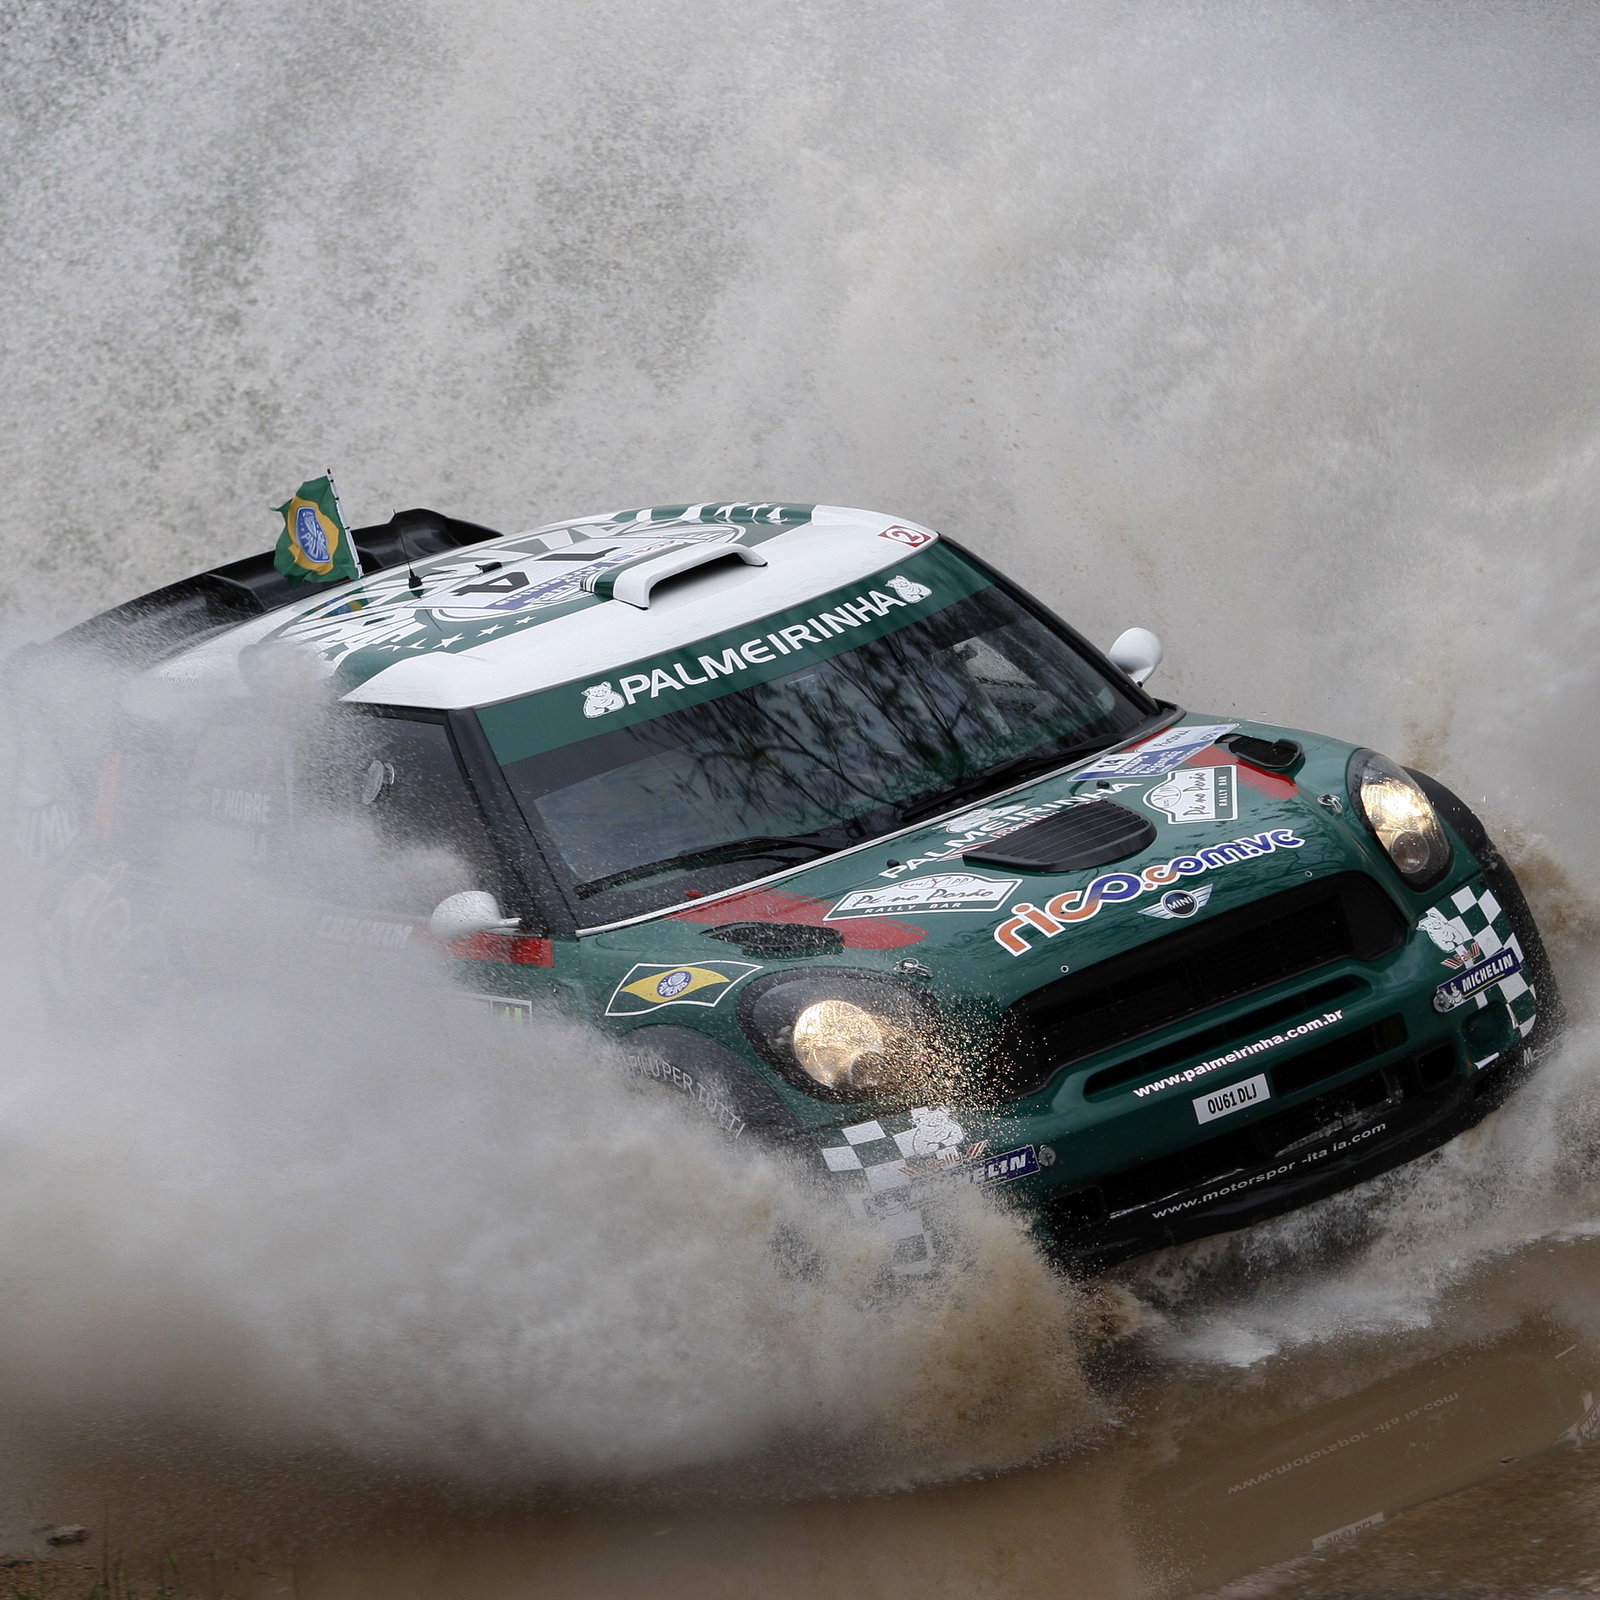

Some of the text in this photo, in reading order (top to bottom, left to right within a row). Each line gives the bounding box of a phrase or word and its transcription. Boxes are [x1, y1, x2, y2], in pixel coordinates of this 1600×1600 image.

[891, 530, 921, 542] 2
[618, 589, 908, 706] PALMEIRINHA
[1218, 789, 1228, 807] RALLY
[878, 782, 1145, 880] PALMEIRINHA
[864, 904, 917, 914] RALLY
[994, 829, 1306, 957] rico.com.vc
[1167, 896, 1194, 910] MINI
[1461, 953, 1515, 993] MICHELIN
[1133, 1008, 1344, 1099] www.palmeirinha.com.br
[661, 1060, 697, 1099] PER
[696, 1081, 746, 1140] TUTTI
[1237, 1082, 1257, 1104] DLJ
